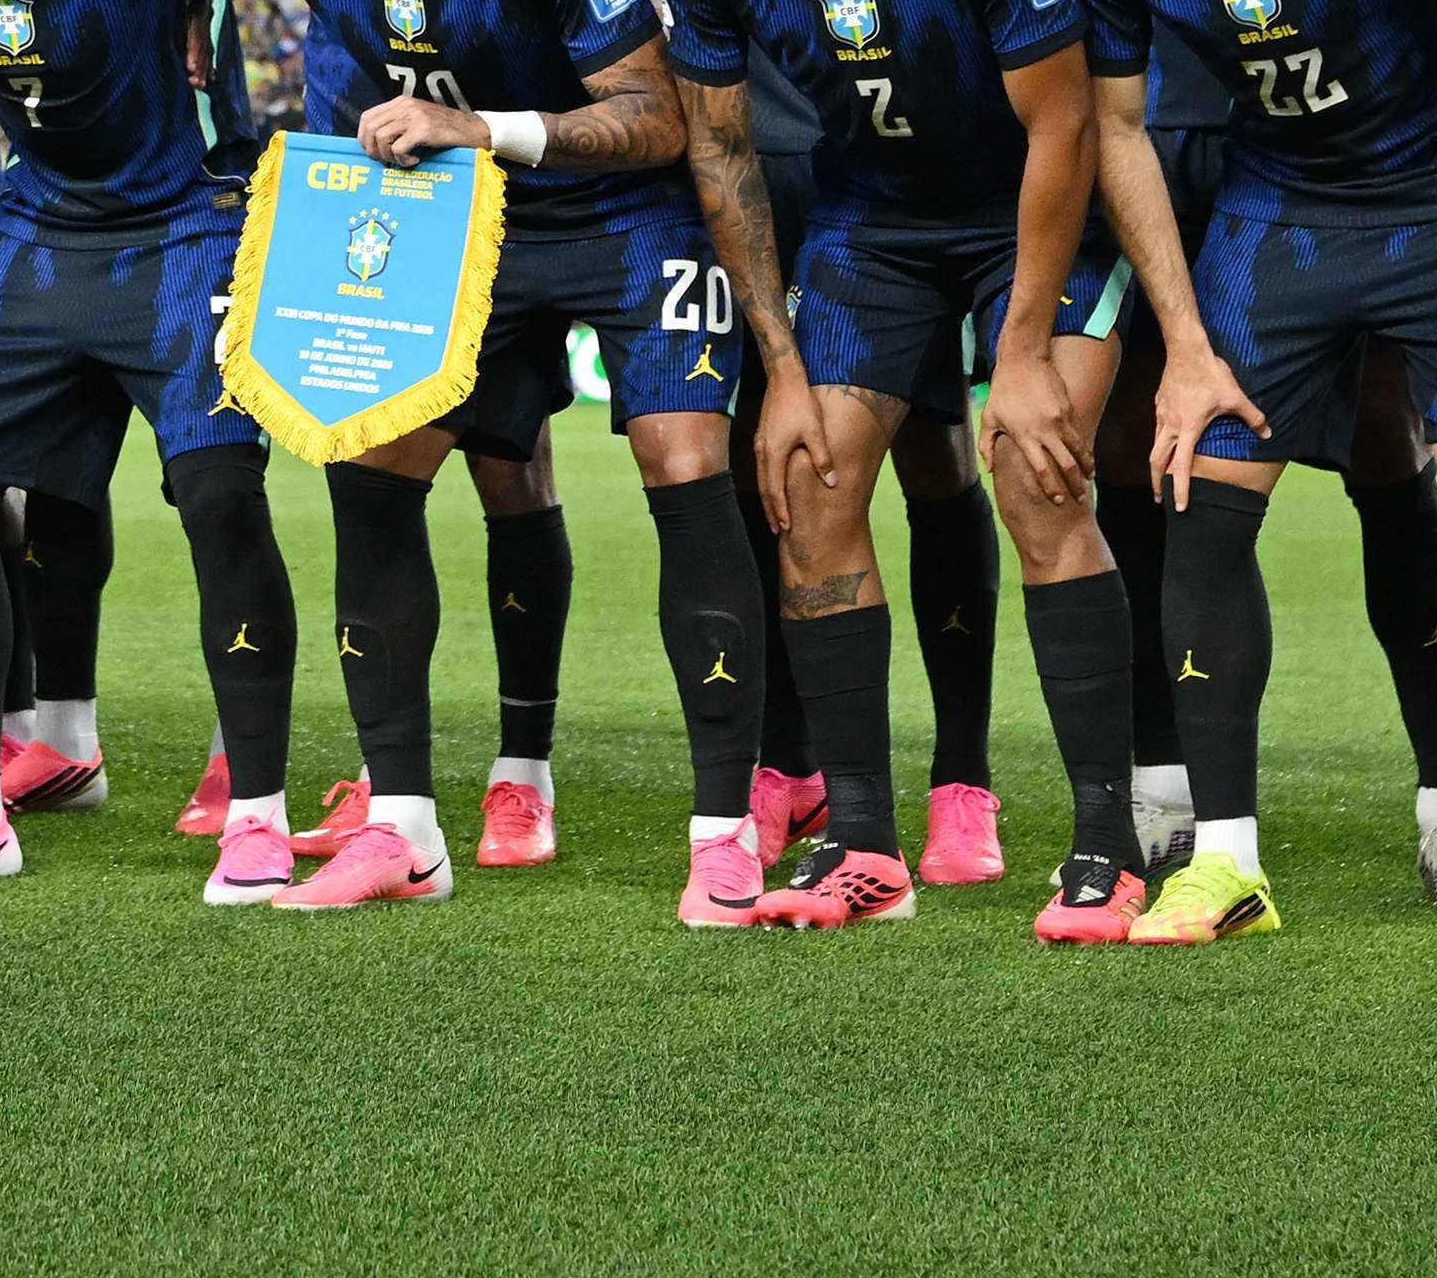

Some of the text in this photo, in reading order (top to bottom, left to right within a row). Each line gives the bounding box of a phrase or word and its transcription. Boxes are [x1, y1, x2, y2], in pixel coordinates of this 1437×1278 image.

[839, 6, 861, 17] CBF
[1237, 23, 1300, 45] BRASIL
[389, 38, 438, 54] BRASIL
[836, 46, 893, 62] BRASIL
[1240, 47, 1350, 117] 22
[7, 76, 45, 128] 7
[307, 161, 371, 193] CBF
[337, 282, 386, 300] BRASIL
[661, 258, 733, 335] 20
